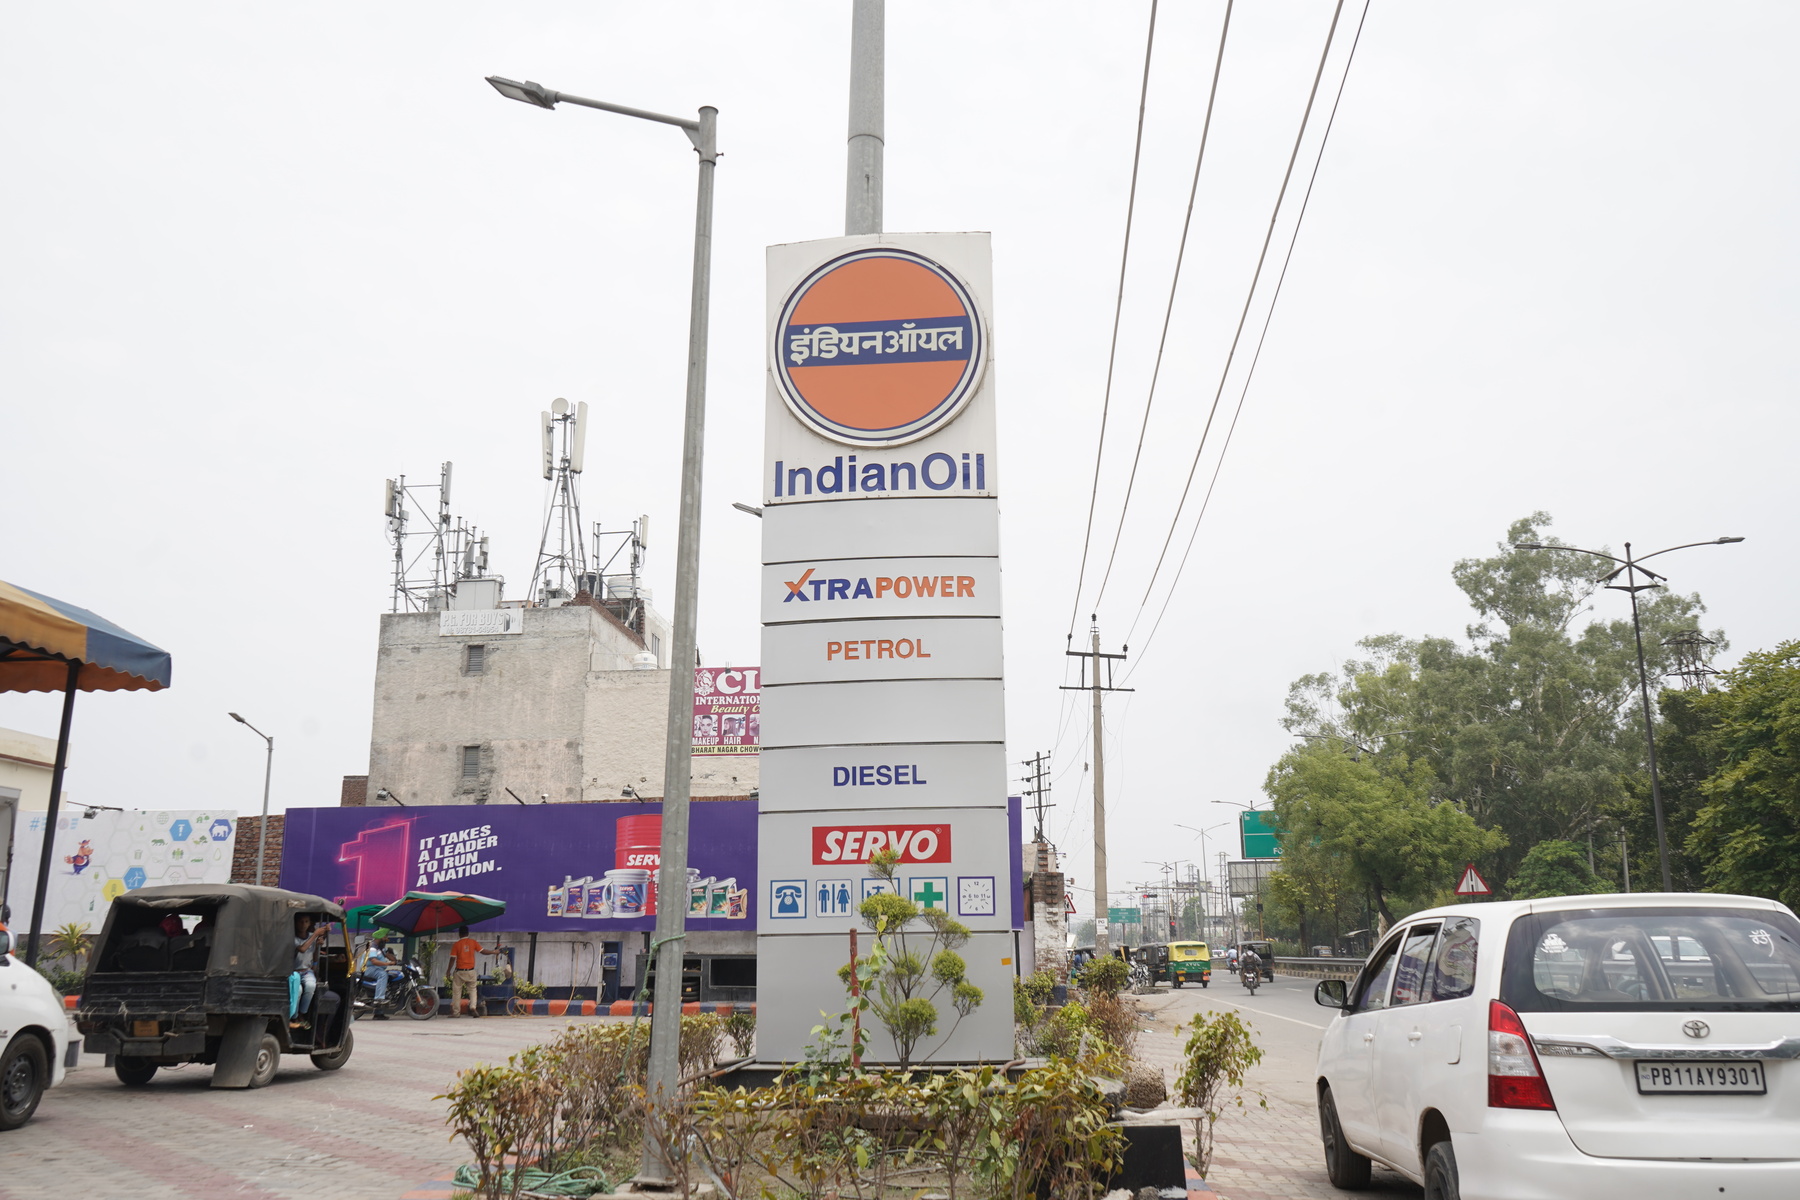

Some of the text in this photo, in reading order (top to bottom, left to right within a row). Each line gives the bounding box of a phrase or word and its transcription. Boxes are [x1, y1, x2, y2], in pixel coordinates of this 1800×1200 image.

[790, 322, 963, 365] इंडियनऑयल
[774, 452, 986, 497] IndianOil
[783, 568, 976, 602] XTRAPOWER
[460, 612, 478, 626] FOR
[479, 611, 504, 626] BOYS
[826, 638, 931, 661] PETROL
[711, 704, 760, 714] Beauty C
[692, 736, 719, 745] MAKEUP
[724, 736, 741, 744] HAIR
[833, 764, 927, 787] DIESEL
[418, 835, 498, 862] A LEADER
[420, 825, 491, 850] IT TAKES
[821, 830, 939, 861] SERVO
[416, 860, 502, 887] A NATION.
[418, 851, 478, 874] TO RUN
[1651, 1067, 1760, 1085] PB11AY9301
